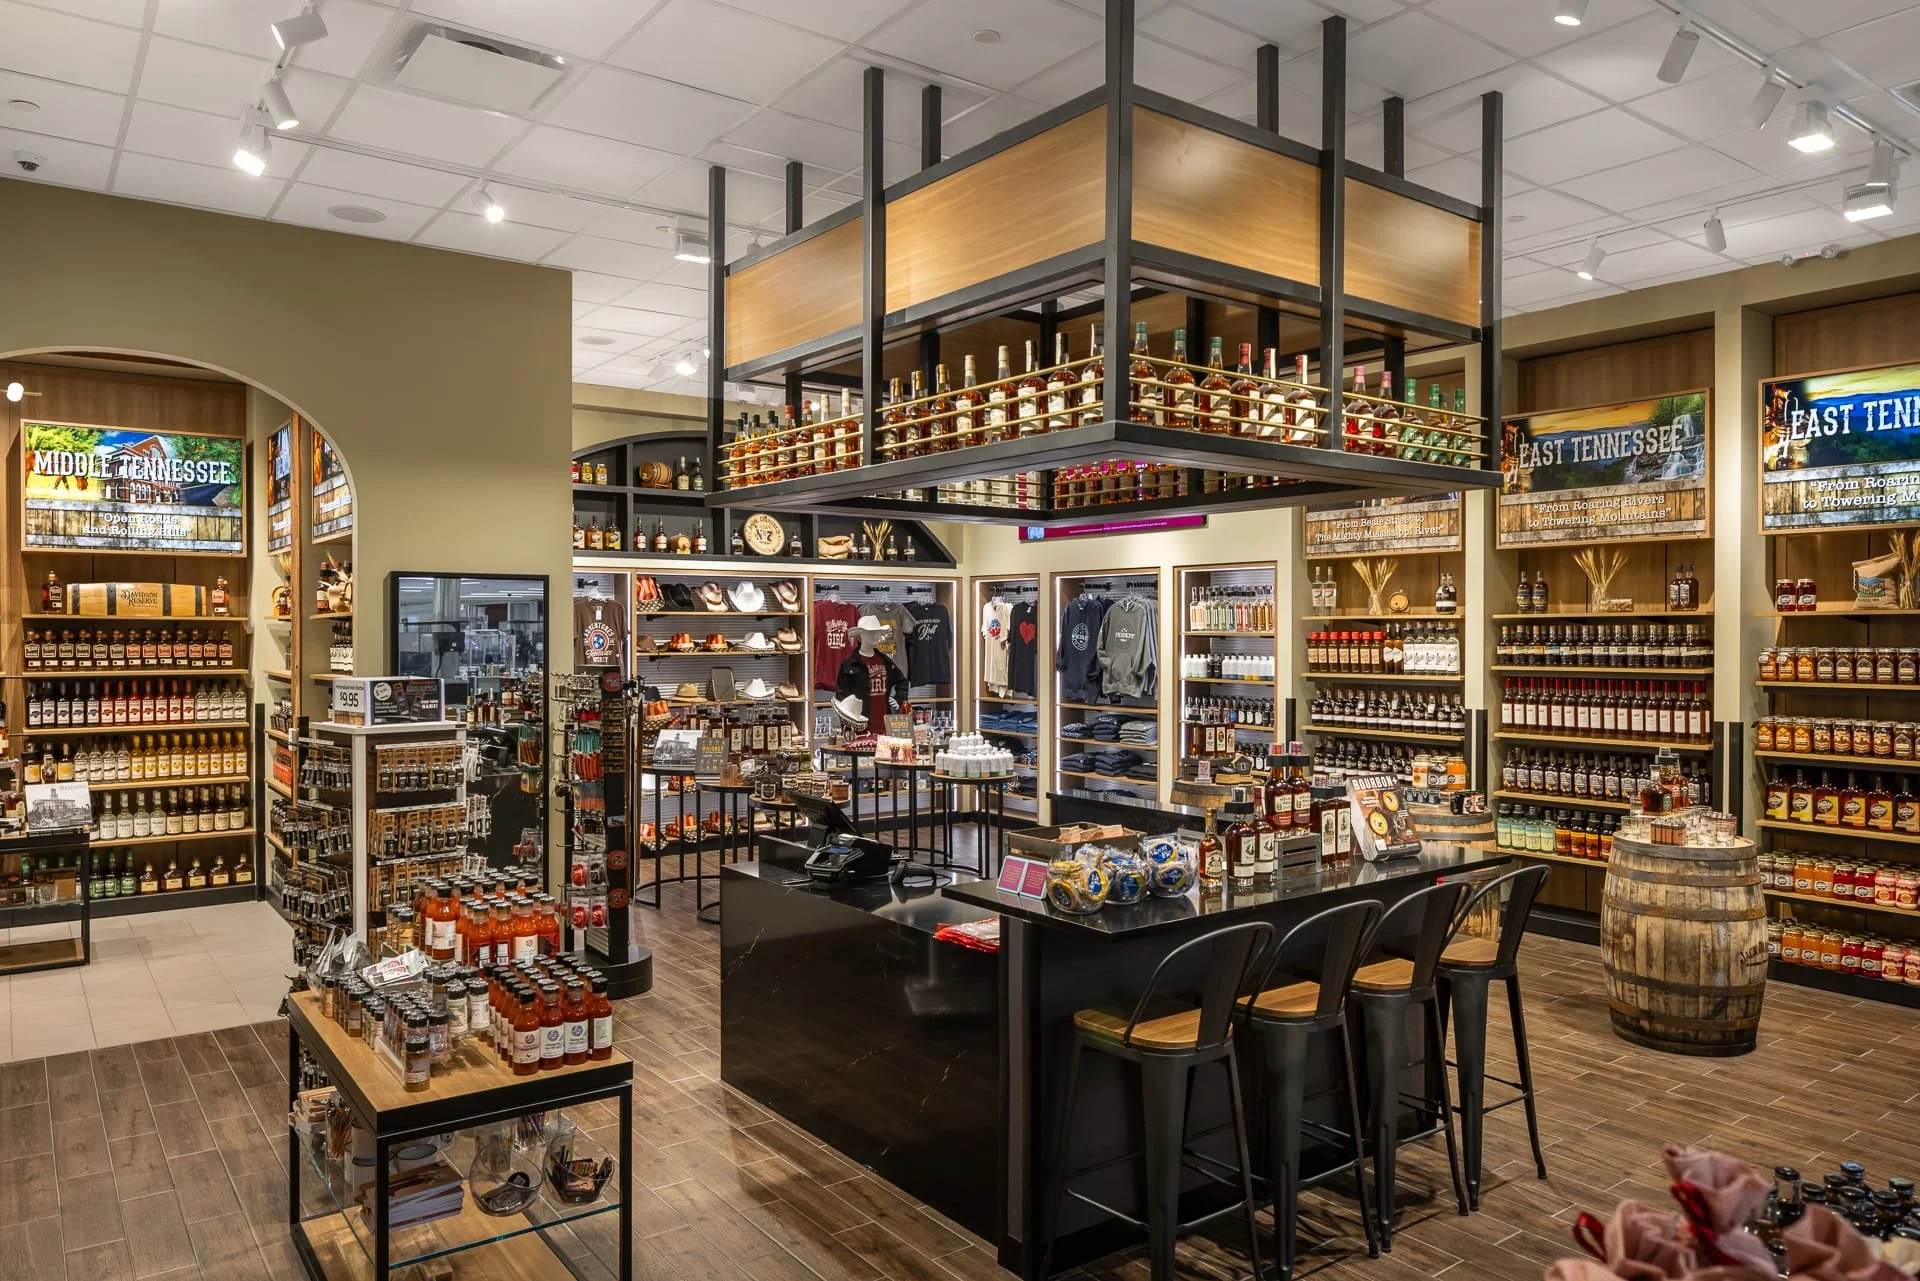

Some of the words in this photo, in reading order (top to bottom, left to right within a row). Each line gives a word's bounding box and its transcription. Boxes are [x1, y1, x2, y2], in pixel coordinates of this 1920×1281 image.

[1790, 404, 1854, 440] EAST
[1519, 439, 1565, 469] EAST
[1571, 424, 1684, 463] TENNESSEE
[34, 450, 113, 478] MIDDLE
[119, 457, 232, 484] TENNESSEE
[1572, 498, 1620, 511] Roaring
[1623, 495, 1665, 506] Rivers
[1803, 499, 1817, 508] to
[1822, 493, 1896, 506] Towering
[139, 513, 178, 525] Roads
[1361, 518, 1384, 527] Beale
[1415, 515, 1425, 523] to
[1528, 518, 1539, 528] to
[1541, 514, 1596, 527] Towering
[108, 525, 157, 537] Rolling
[1316, 533, 1331, 542] The
[1333, 532, 1362, 542] Mighty
[1364, 528, 1413, 539] Mississippi
[827, 632, 846, 647] GIRL
[340, 691, 358, 707] $9.95
[1352, 775, 1398, 791] BOURBON+
